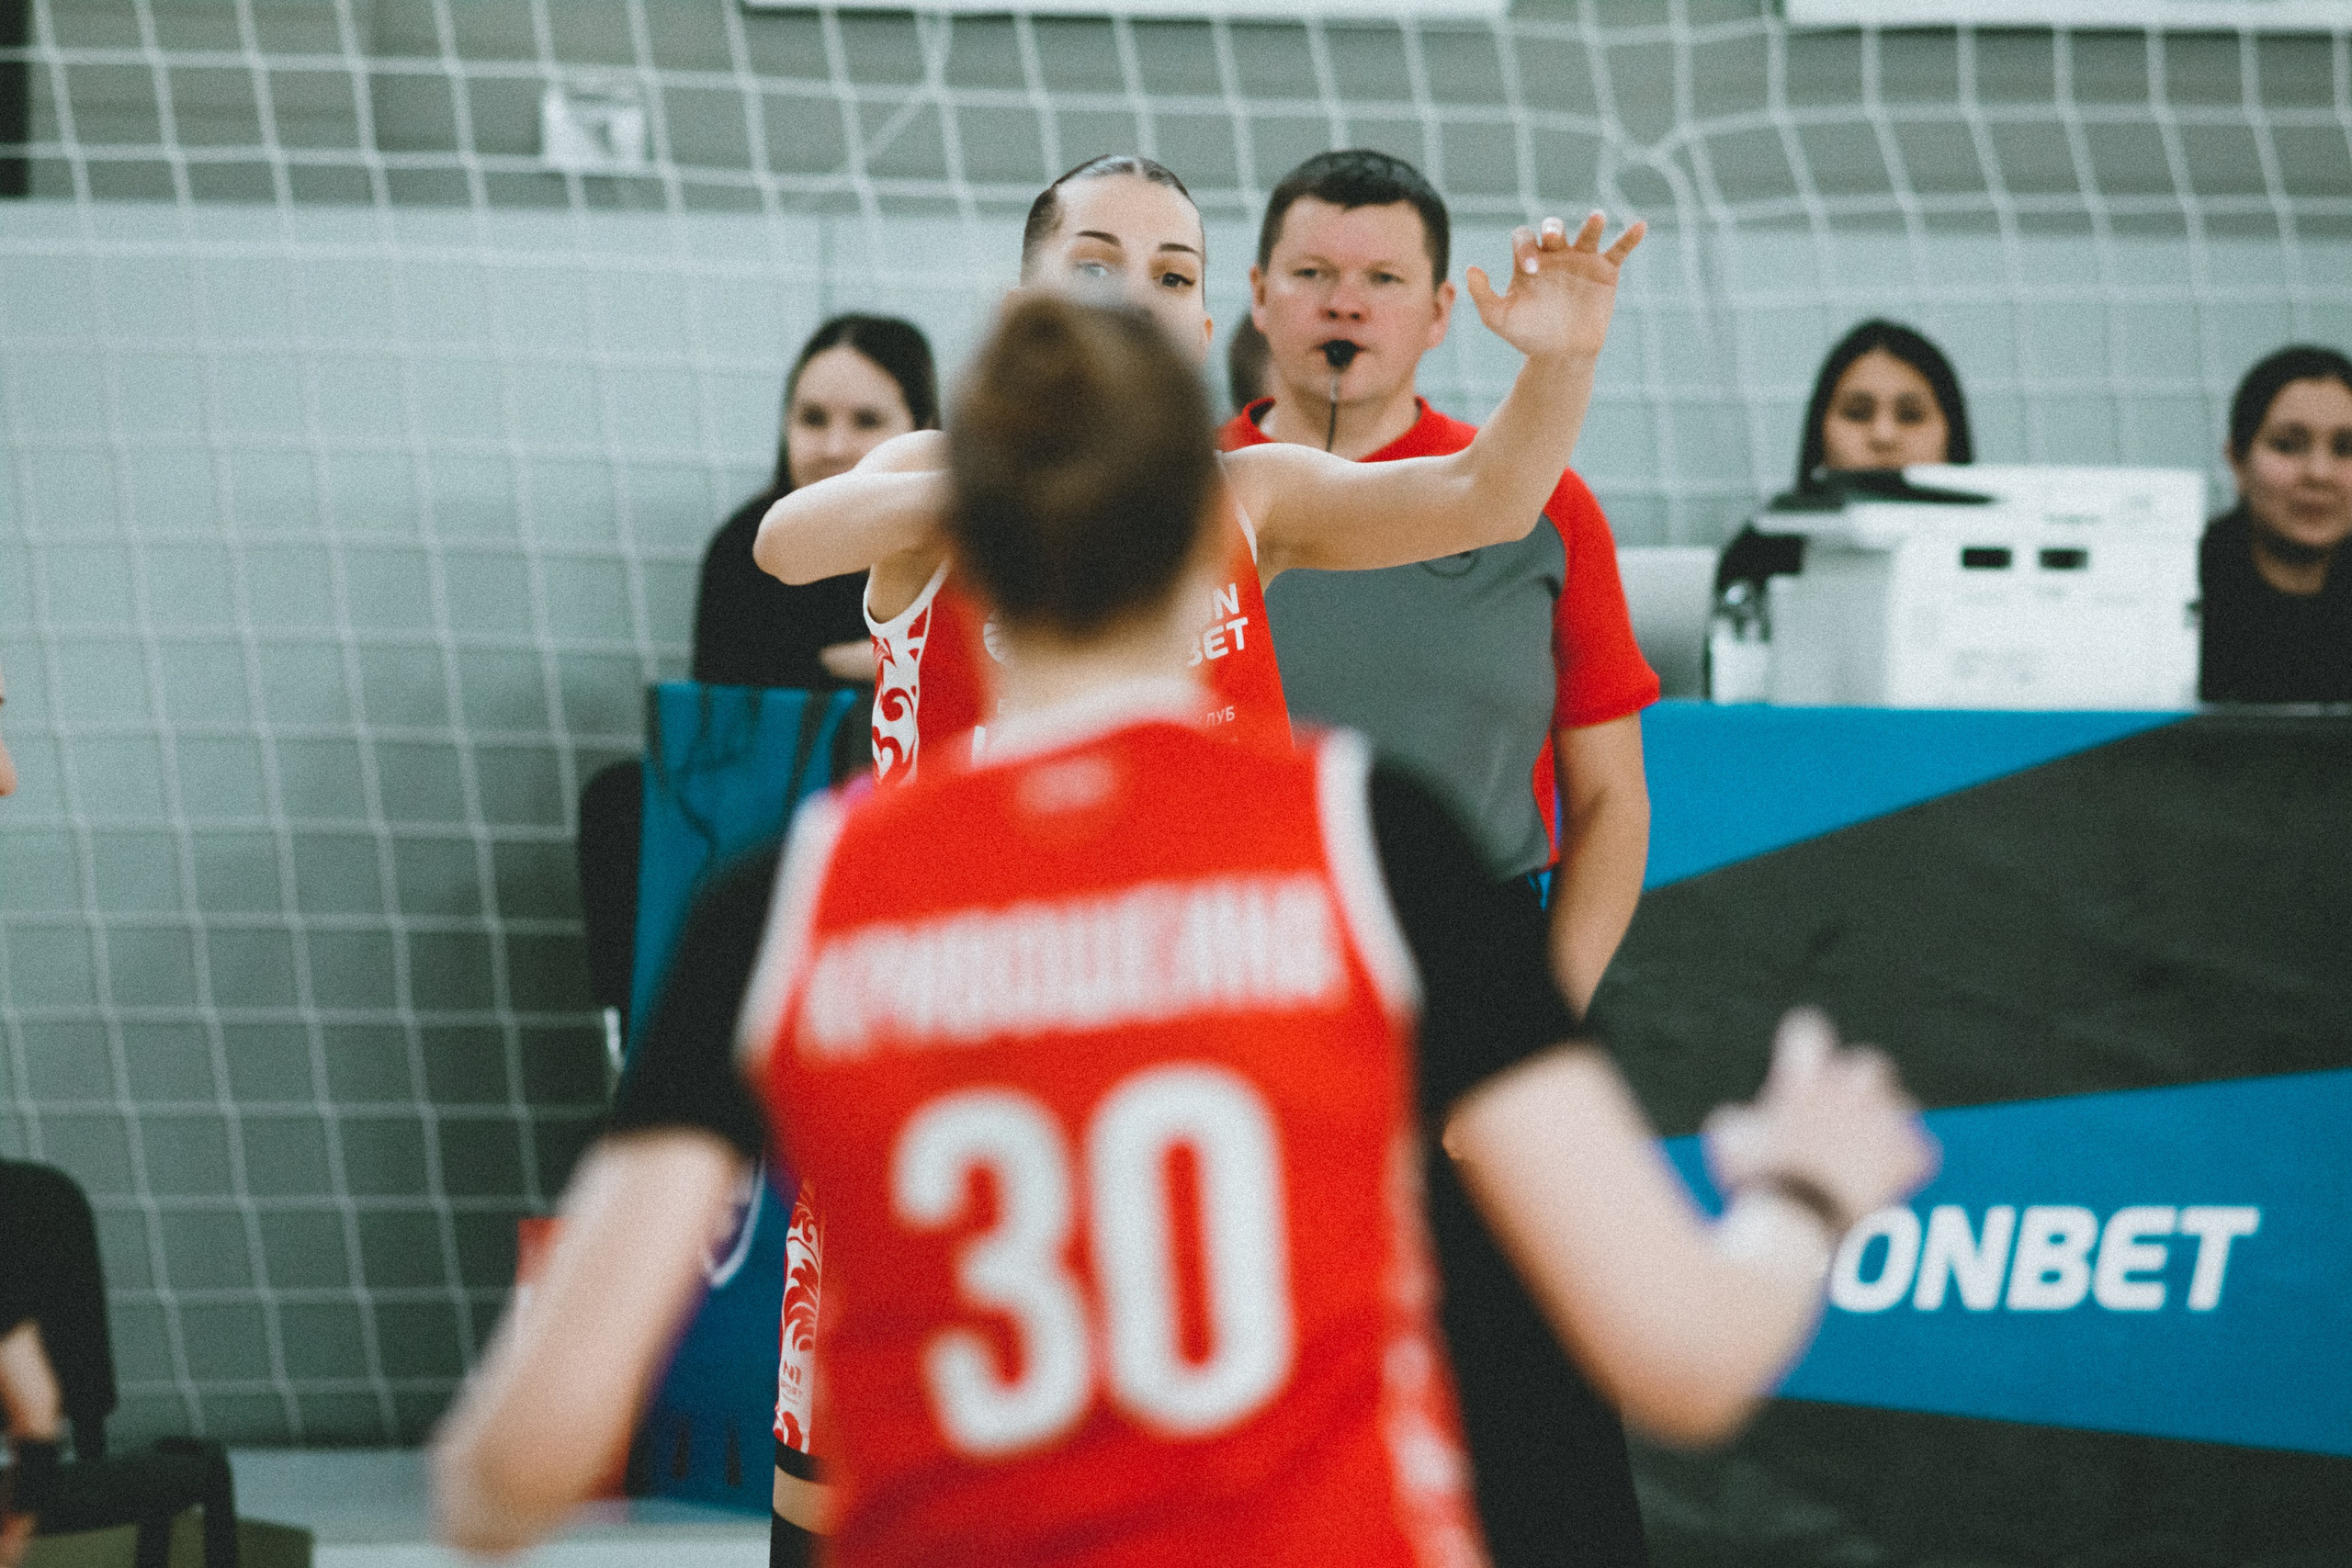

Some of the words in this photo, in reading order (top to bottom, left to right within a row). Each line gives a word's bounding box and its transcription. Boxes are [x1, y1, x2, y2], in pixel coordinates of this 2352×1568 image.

[1199, 705, 1236, 725] ЛУБ
[895, 1071, 1295, 1451] 30
[1831, 1204, 2261, 1313] ONBET
